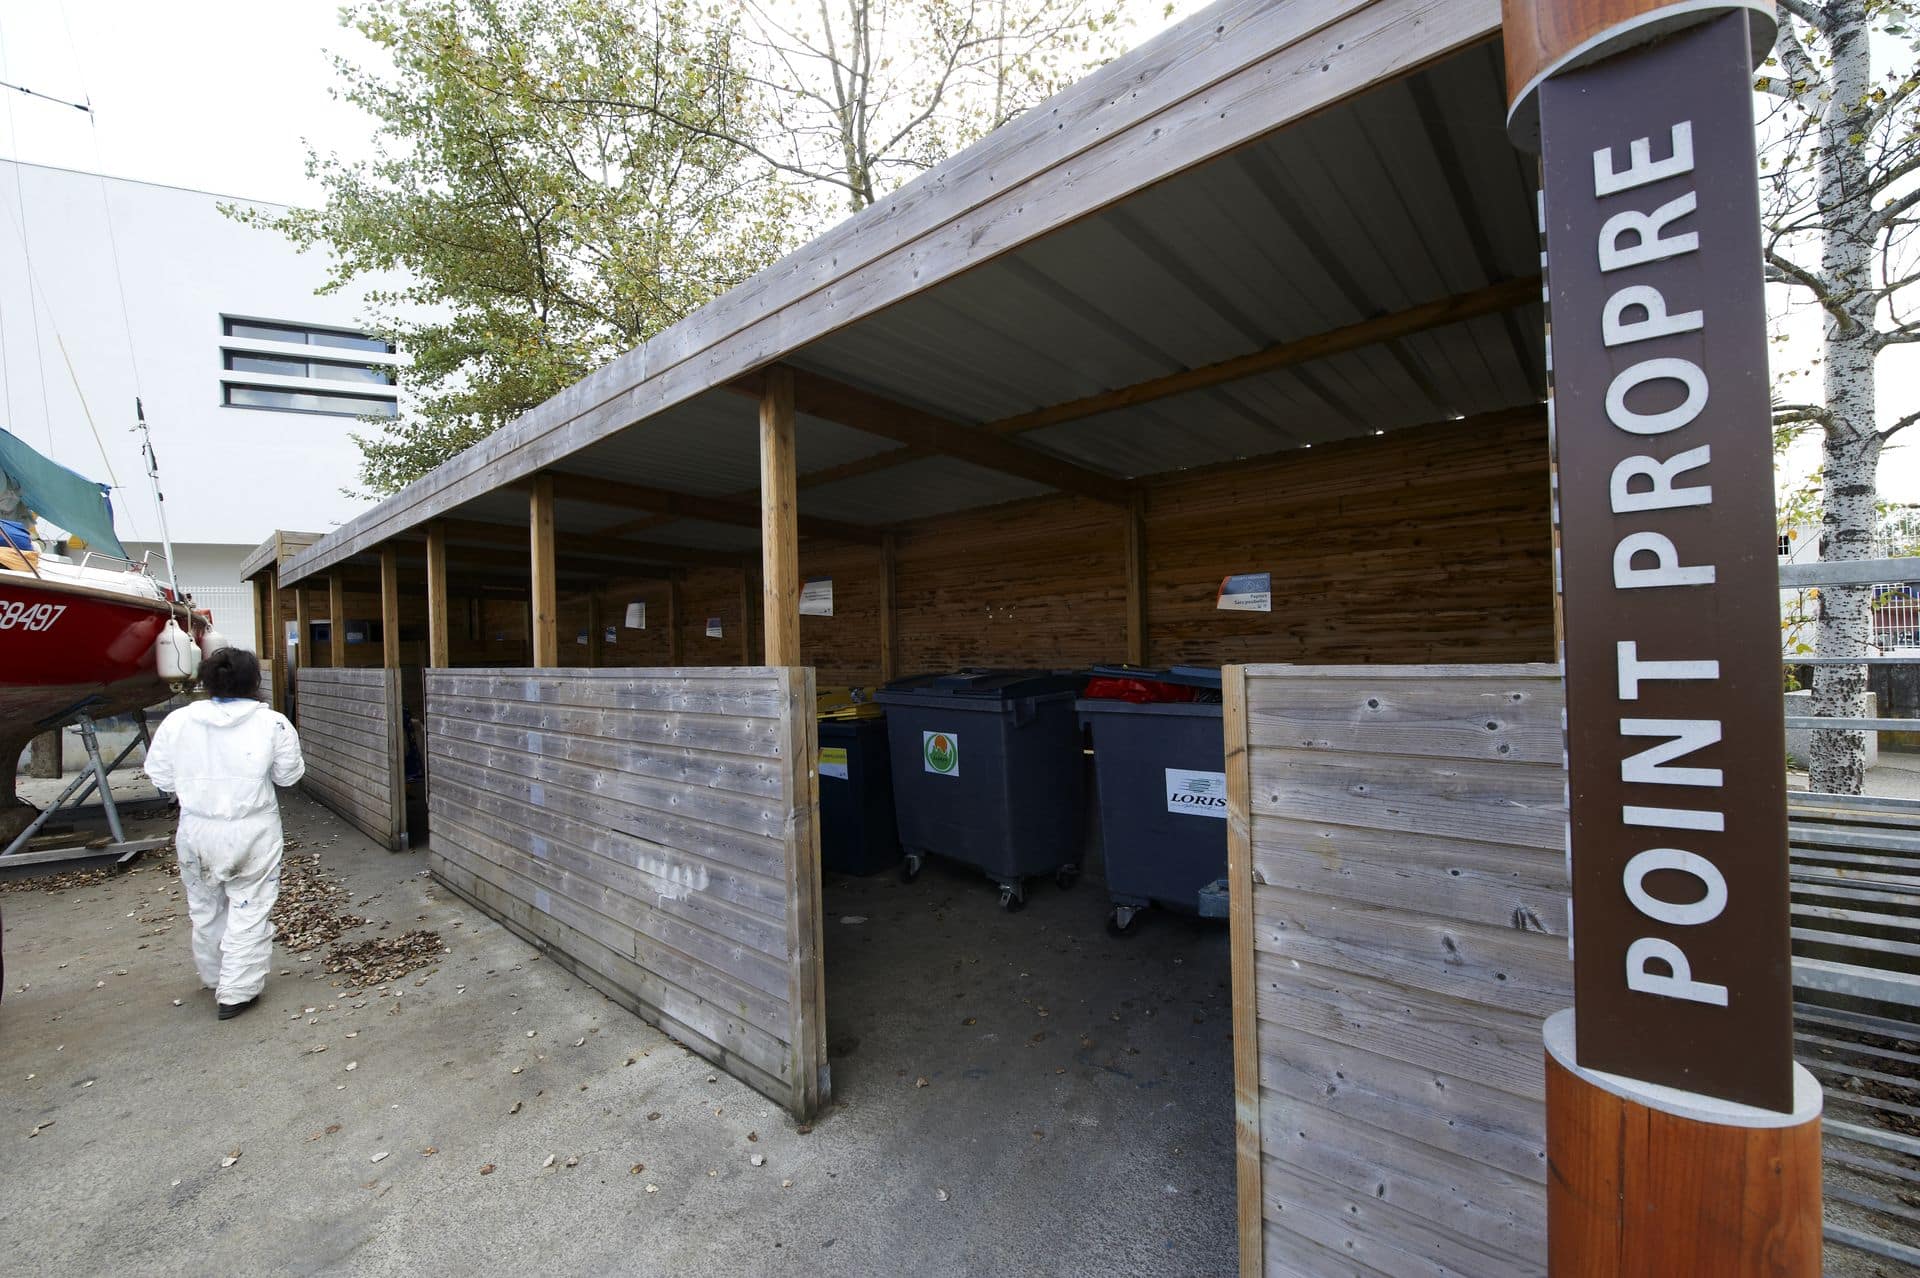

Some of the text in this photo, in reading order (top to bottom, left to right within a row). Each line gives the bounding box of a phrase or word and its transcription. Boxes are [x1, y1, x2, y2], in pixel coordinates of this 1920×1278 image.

[1593, 120, 1728, 1007] POINT PROPRE
[1170, 792, 1227, 808] LORIS
